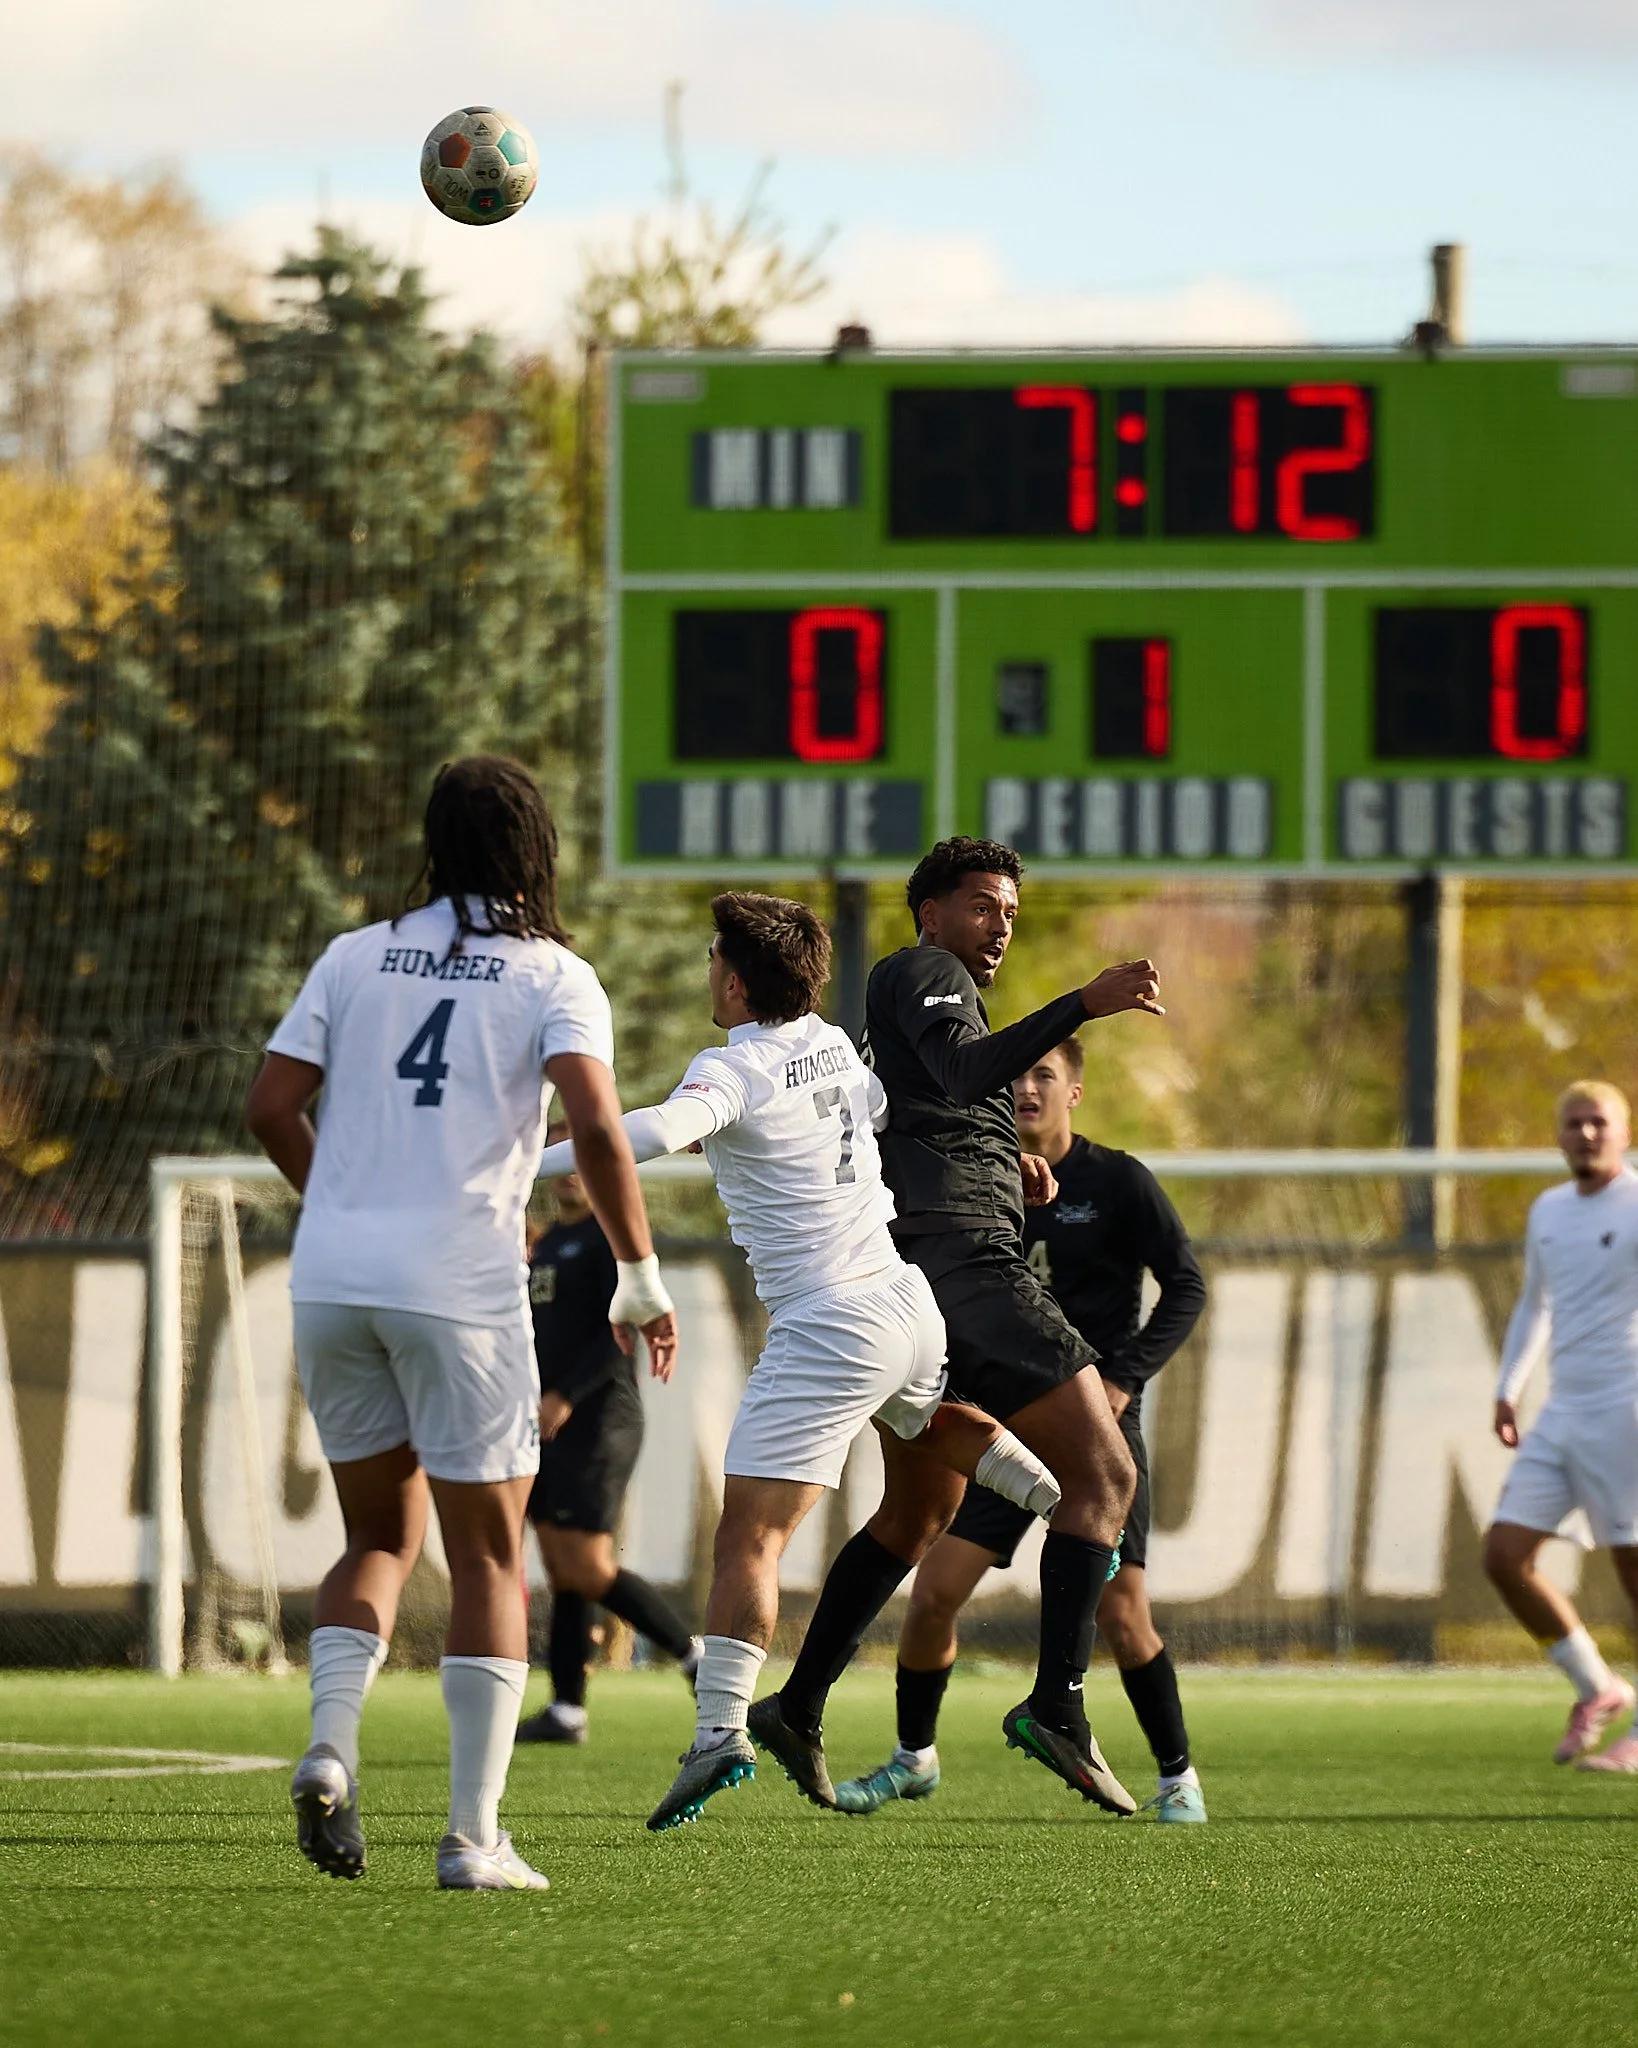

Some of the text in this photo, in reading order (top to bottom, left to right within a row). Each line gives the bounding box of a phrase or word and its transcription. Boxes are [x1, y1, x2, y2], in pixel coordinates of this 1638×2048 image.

[1014, 383, 1372, 541] 7:12
[789, 606, 883, 763] 0
[1143, 640, 1169, 757] 1
[1491, 604, 1585, 761] 0
[679, 778, 876, 858] HOME
[985, 777, 1270, 859] PERIOD
[1344, 777, 1622, 859] GUESTS
[379, 948, 505, 984] HUMBER
[396, 998, 457, 1107] 4
[785, 1045, 851, 1089] HUMBER
[812, 1085, 856, 1185] 7
